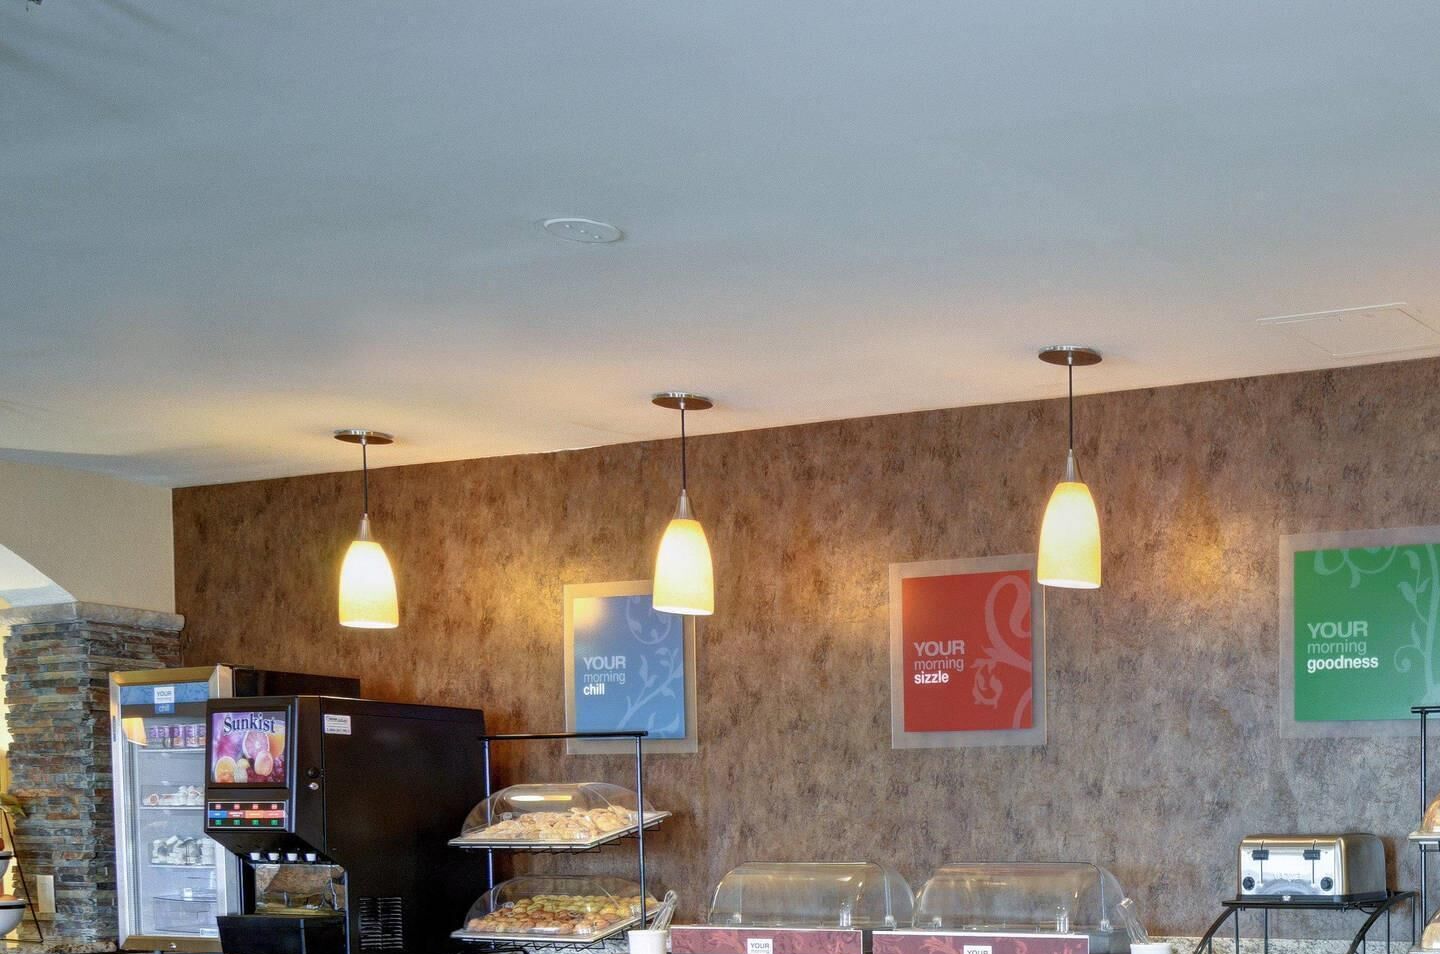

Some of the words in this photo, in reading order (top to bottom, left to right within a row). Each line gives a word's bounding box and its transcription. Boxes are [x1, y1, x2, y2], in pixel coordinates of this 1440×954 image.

[1306, 620, 1369, 639] YOUR
[913, 639, 965, 657] YOUR
[1307, 638, 1367, 656] morning
[583, 655, 626, 670] YOUR
[914, 656, 965, 672] morning
[1306, 653, 1379, 674] goodness
[583, 670, 626, 685] morning
[913, 670, 949, 685] sizzle
[583, 683, 605, 696] chill
[223, 712, 275, 733] Sunkist
